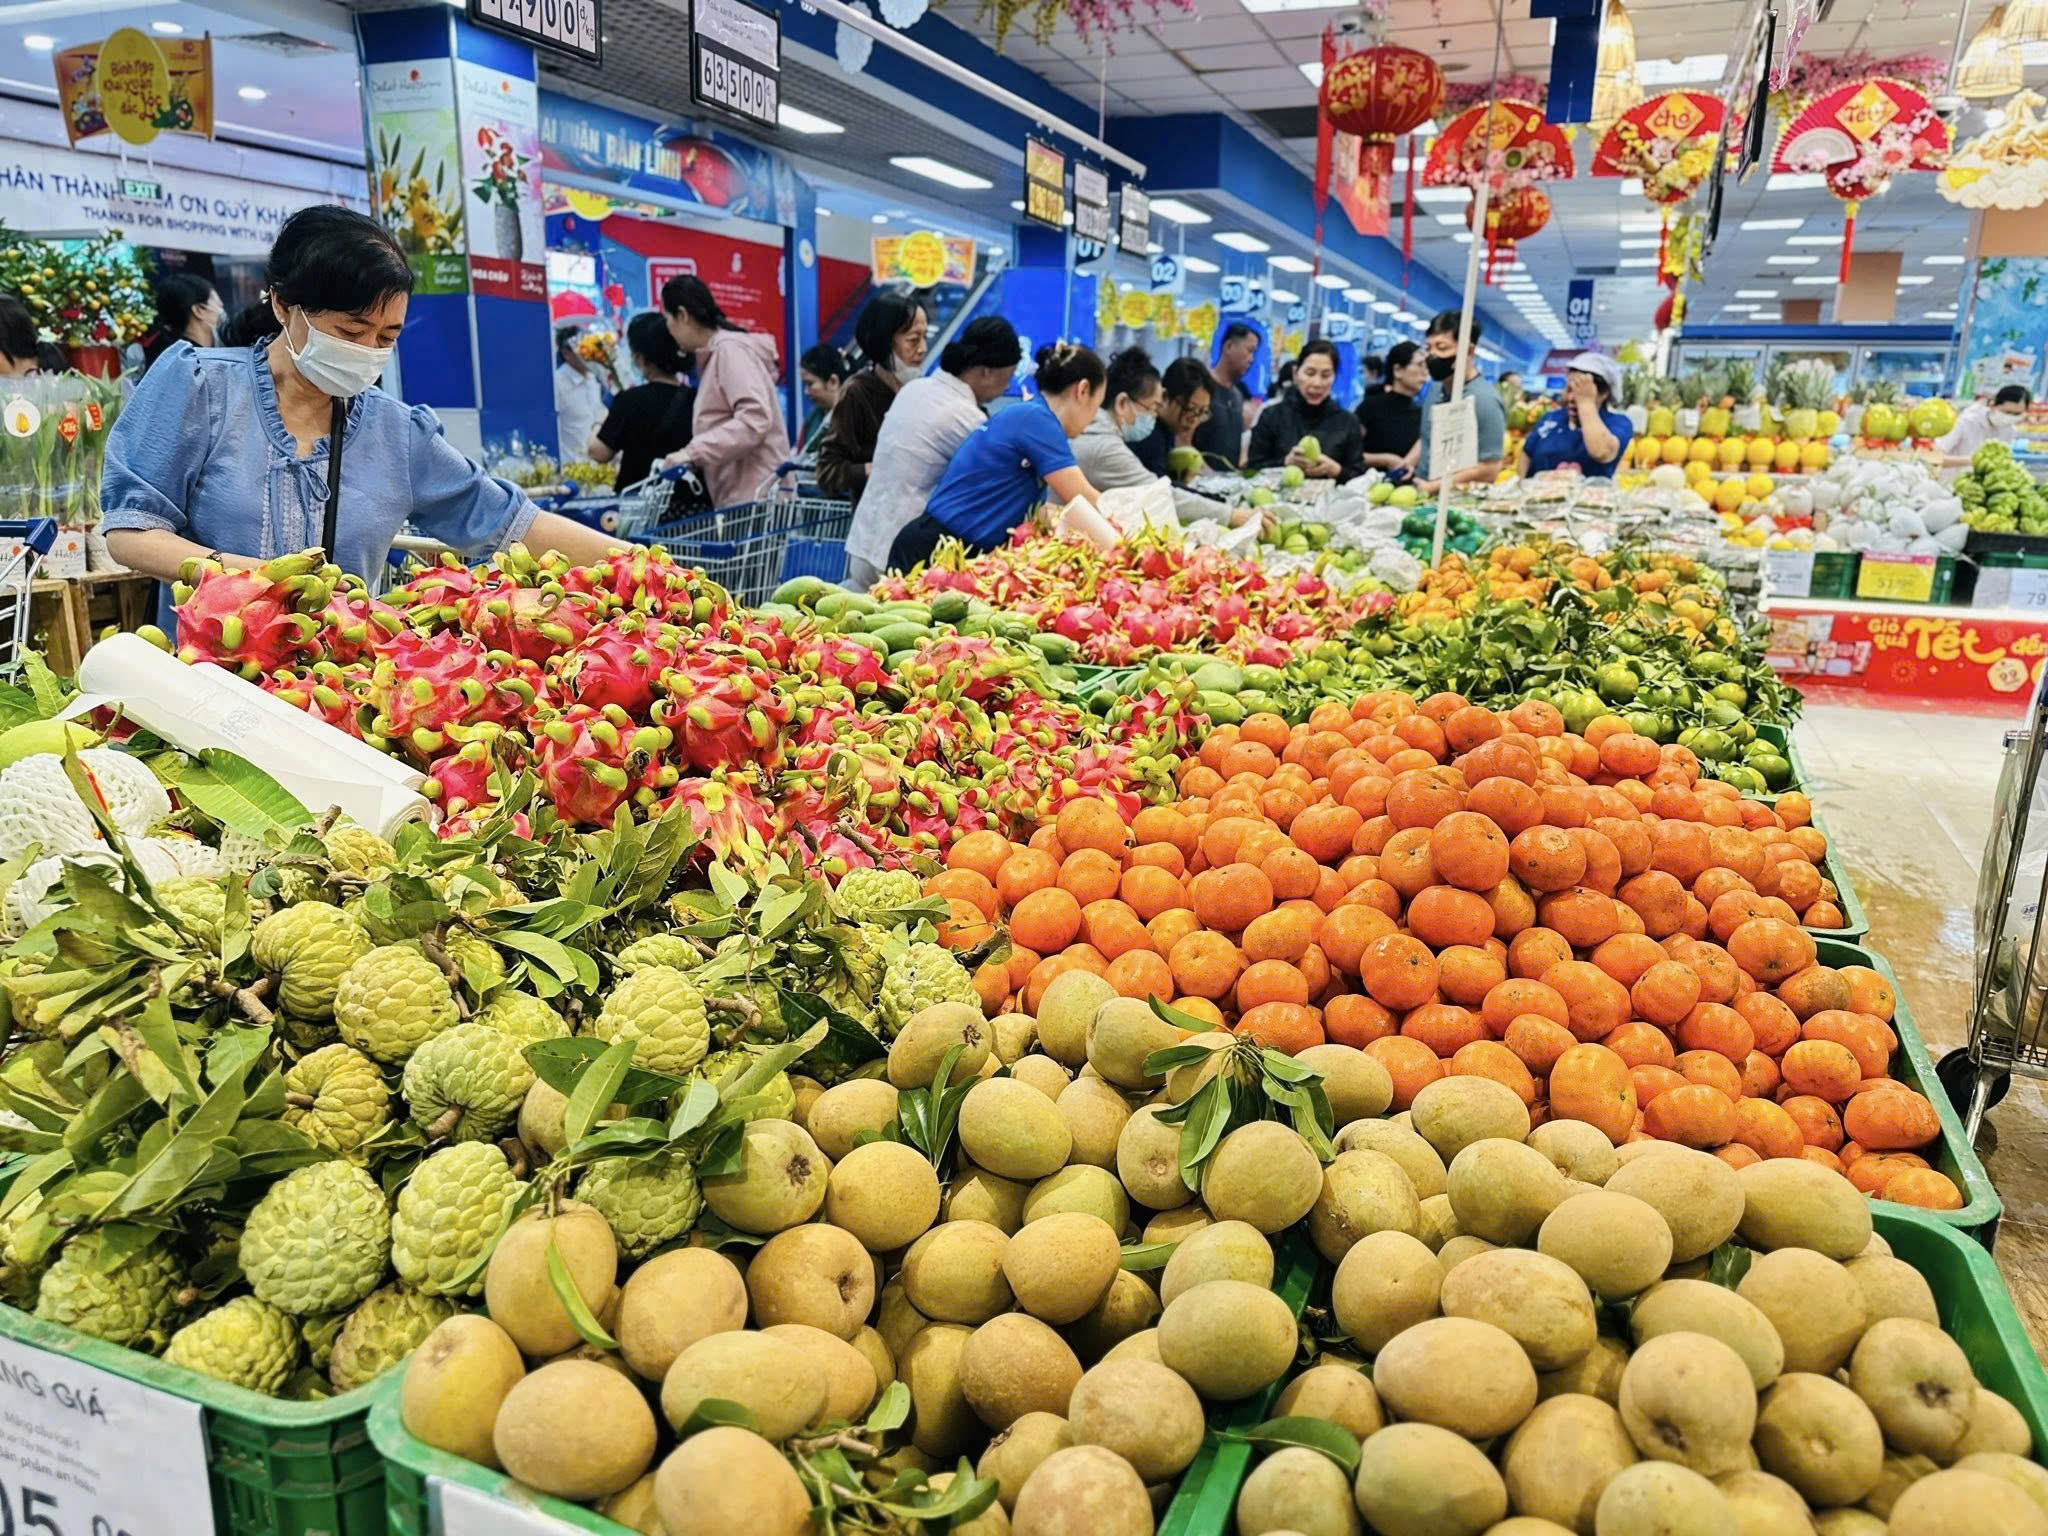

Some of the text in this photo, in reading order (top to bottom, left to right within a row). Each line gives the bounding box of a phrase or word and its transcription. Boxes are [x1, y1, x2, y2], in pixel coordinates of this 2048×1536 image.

[704, 57, 763, 108] 63.500
[50, 173, 121, 200] THÀNH
[180, 194, 208, 214] ƠN
[214, 199, 250, 219] QUÝ
[126, 181, 158, 199] EXIT
[82, 206, 134, 224] THANKS
[138, 213, 162, 228] FOR
[167, 218, 226, 236] SHOPPING
[1152, 265, 1175, 283] 02
[1569, 297, 1591, 316] 01
[1868, 617, 1900, 634] Giỏ
[1904, 617, 2007, 665] Tết
[52, 1382, 108, 1425] GIÁ
